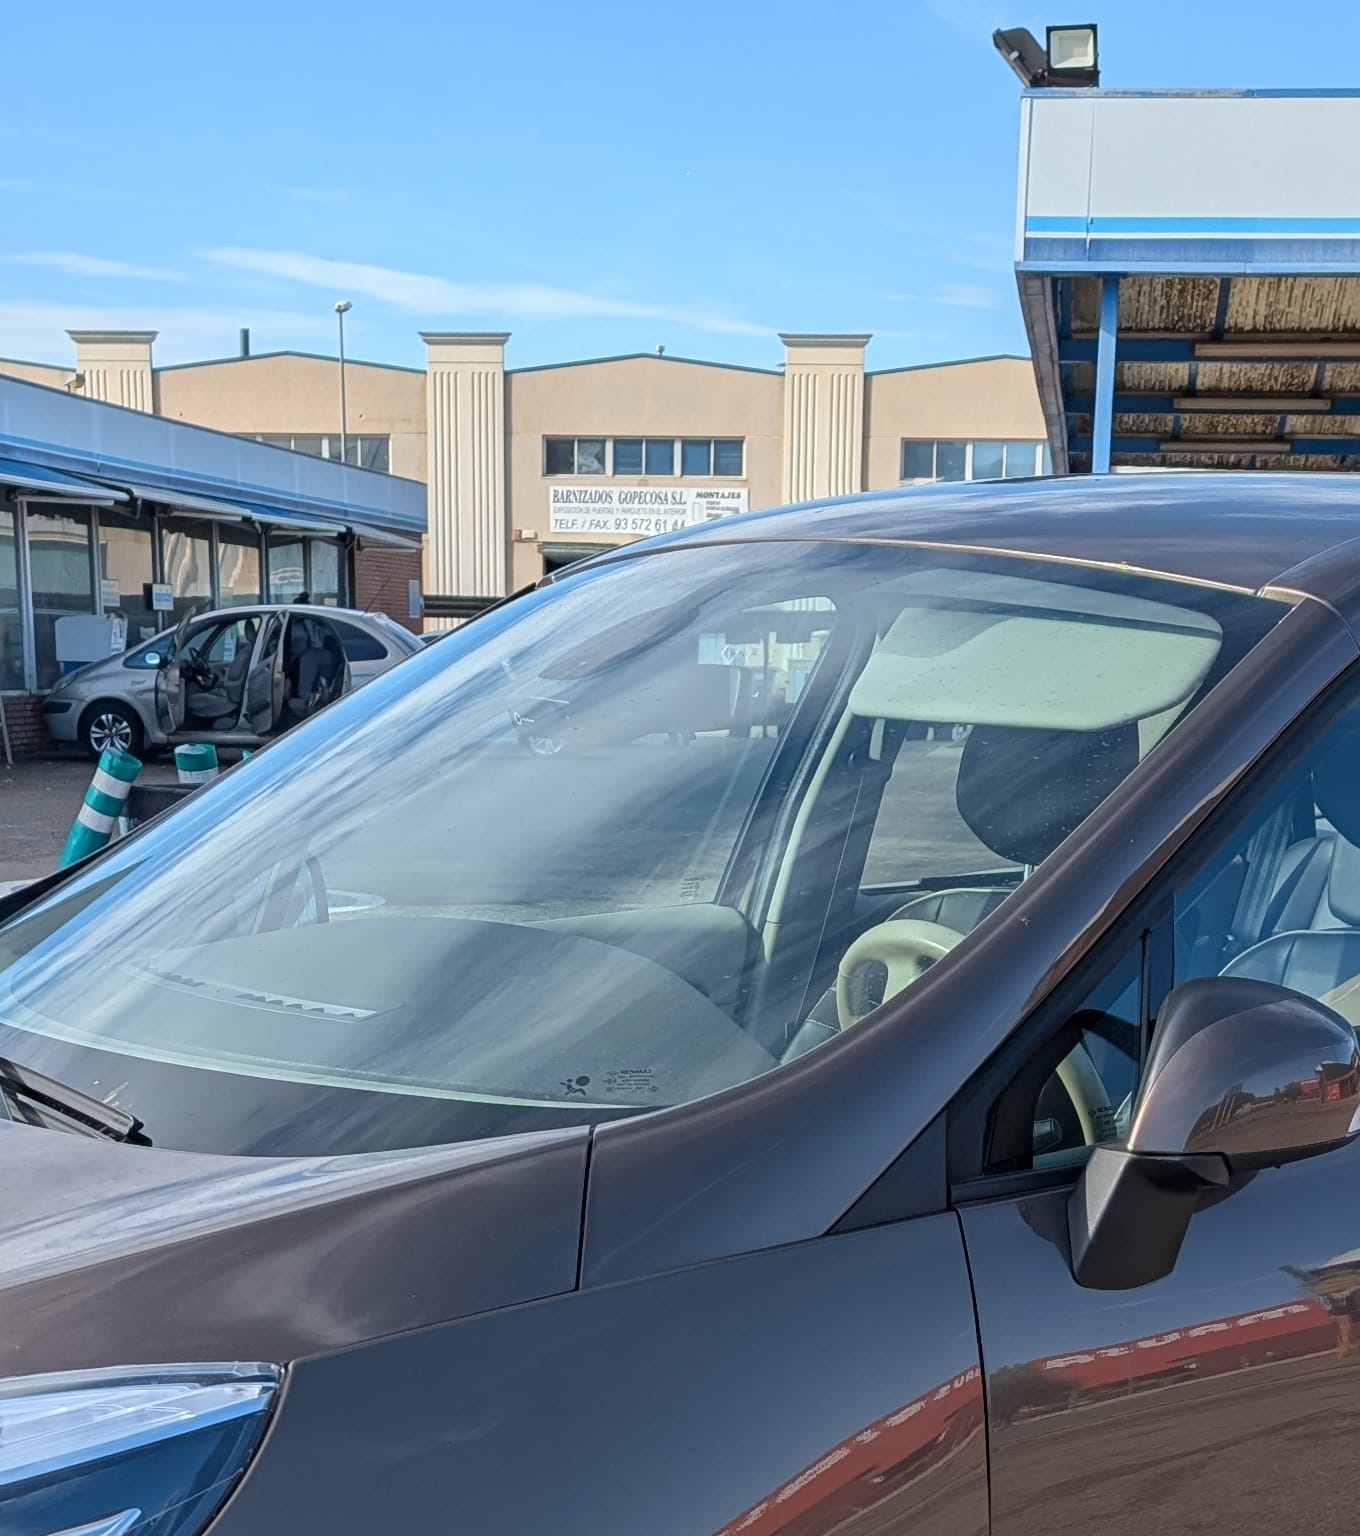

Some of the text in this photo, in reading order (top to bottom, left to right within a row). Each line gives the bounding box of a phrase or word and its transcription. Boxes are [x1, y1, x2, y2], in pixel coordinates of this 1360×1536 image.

[552, 489, 614, 504] BARNIZADOS
[618, 490, 669, 505] GOPECOSA
[695, 491, 742, 499] MONTAJES
[614, 517, 628, 530] 93
[631, 518, 652, 531] 572
[654, 518, 667, 532] 61
